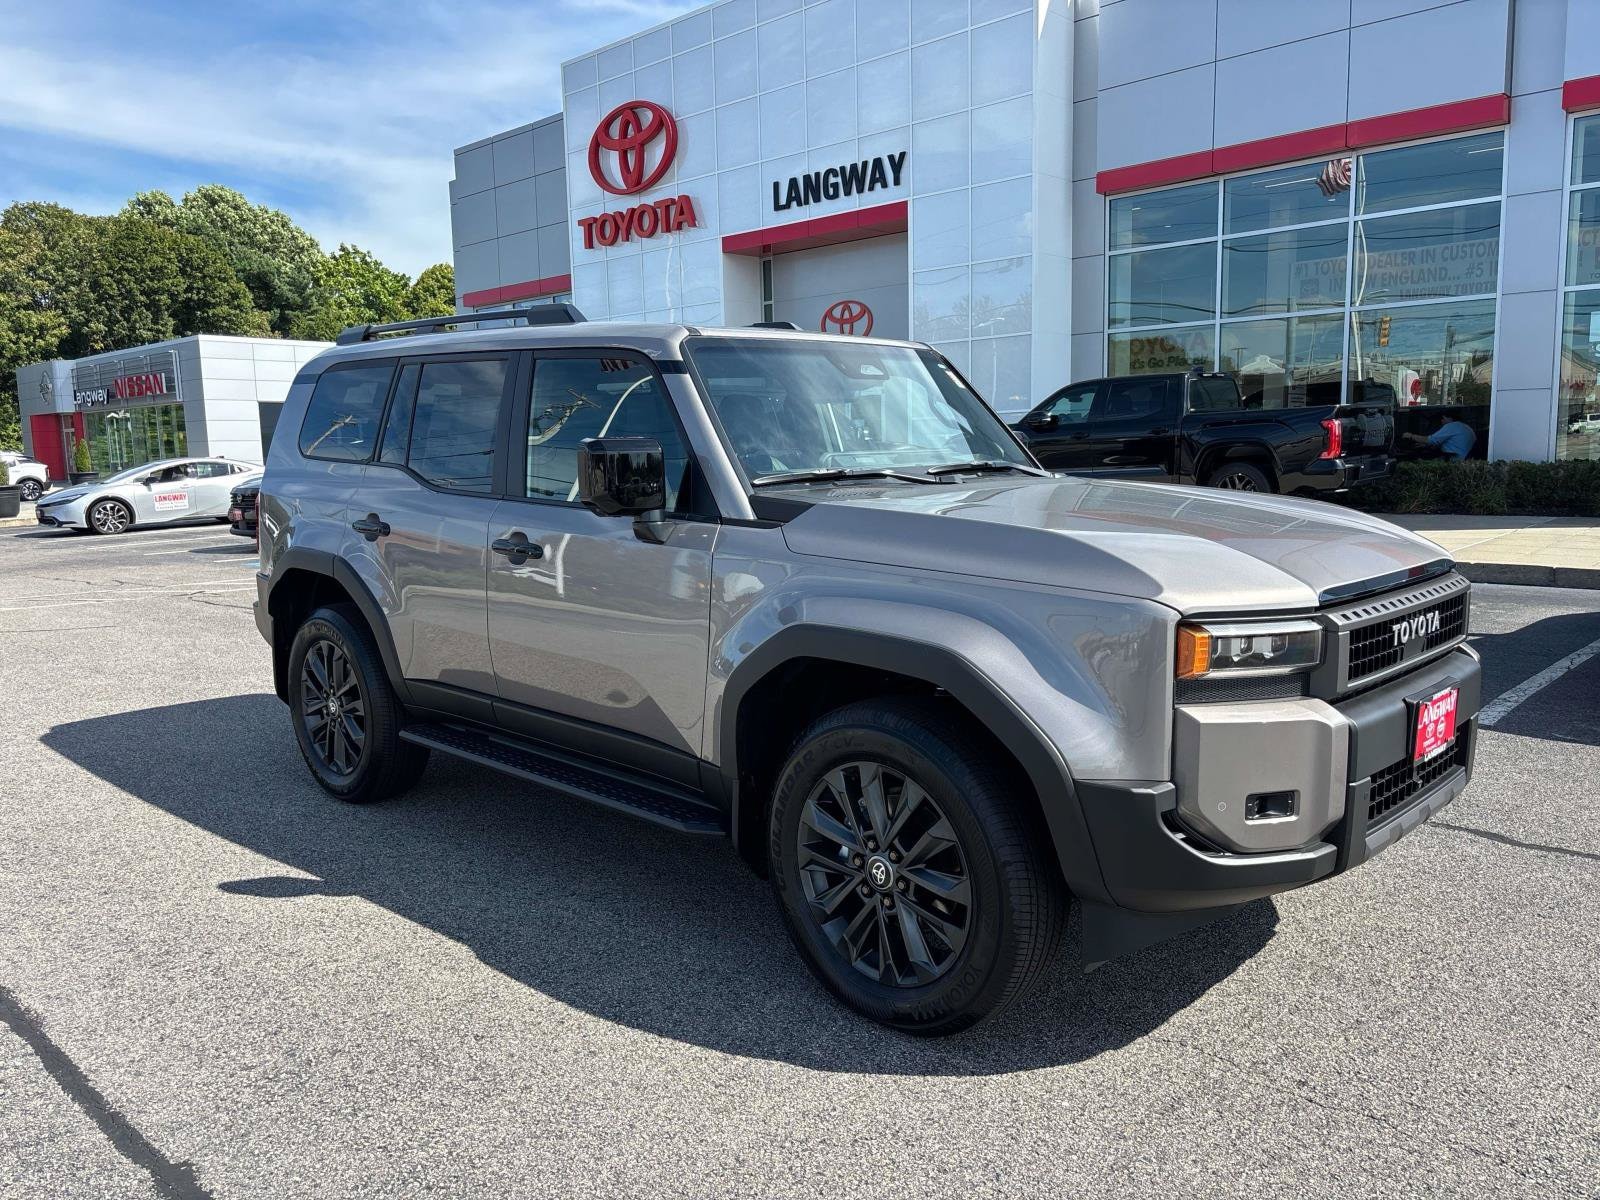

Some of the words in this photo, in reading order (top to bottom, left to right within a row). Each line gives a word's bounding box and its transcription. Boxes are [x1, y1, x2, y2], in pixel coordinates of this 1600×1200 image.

[773, 151, 907, 212] LANGWAY
[578, 195, 698, 250] TOYOTA
[1295, 262, 1309, 279] #1
[1366, 250, 1416, 269] DEALER
[1420, 249, 1436, 265] IN
[1465, 262, 1484, 279] #5
[1147, 357, 1165, 369] Go
[73, 389, 110, 407] Langway
[113, 372, 167, 399] NISSAN
[154, 494, 187, 503] LANGWAY
[1392, 610, 1440, 646] TOYOTA
[1417, 689, 1458, 730] LANGWAY
